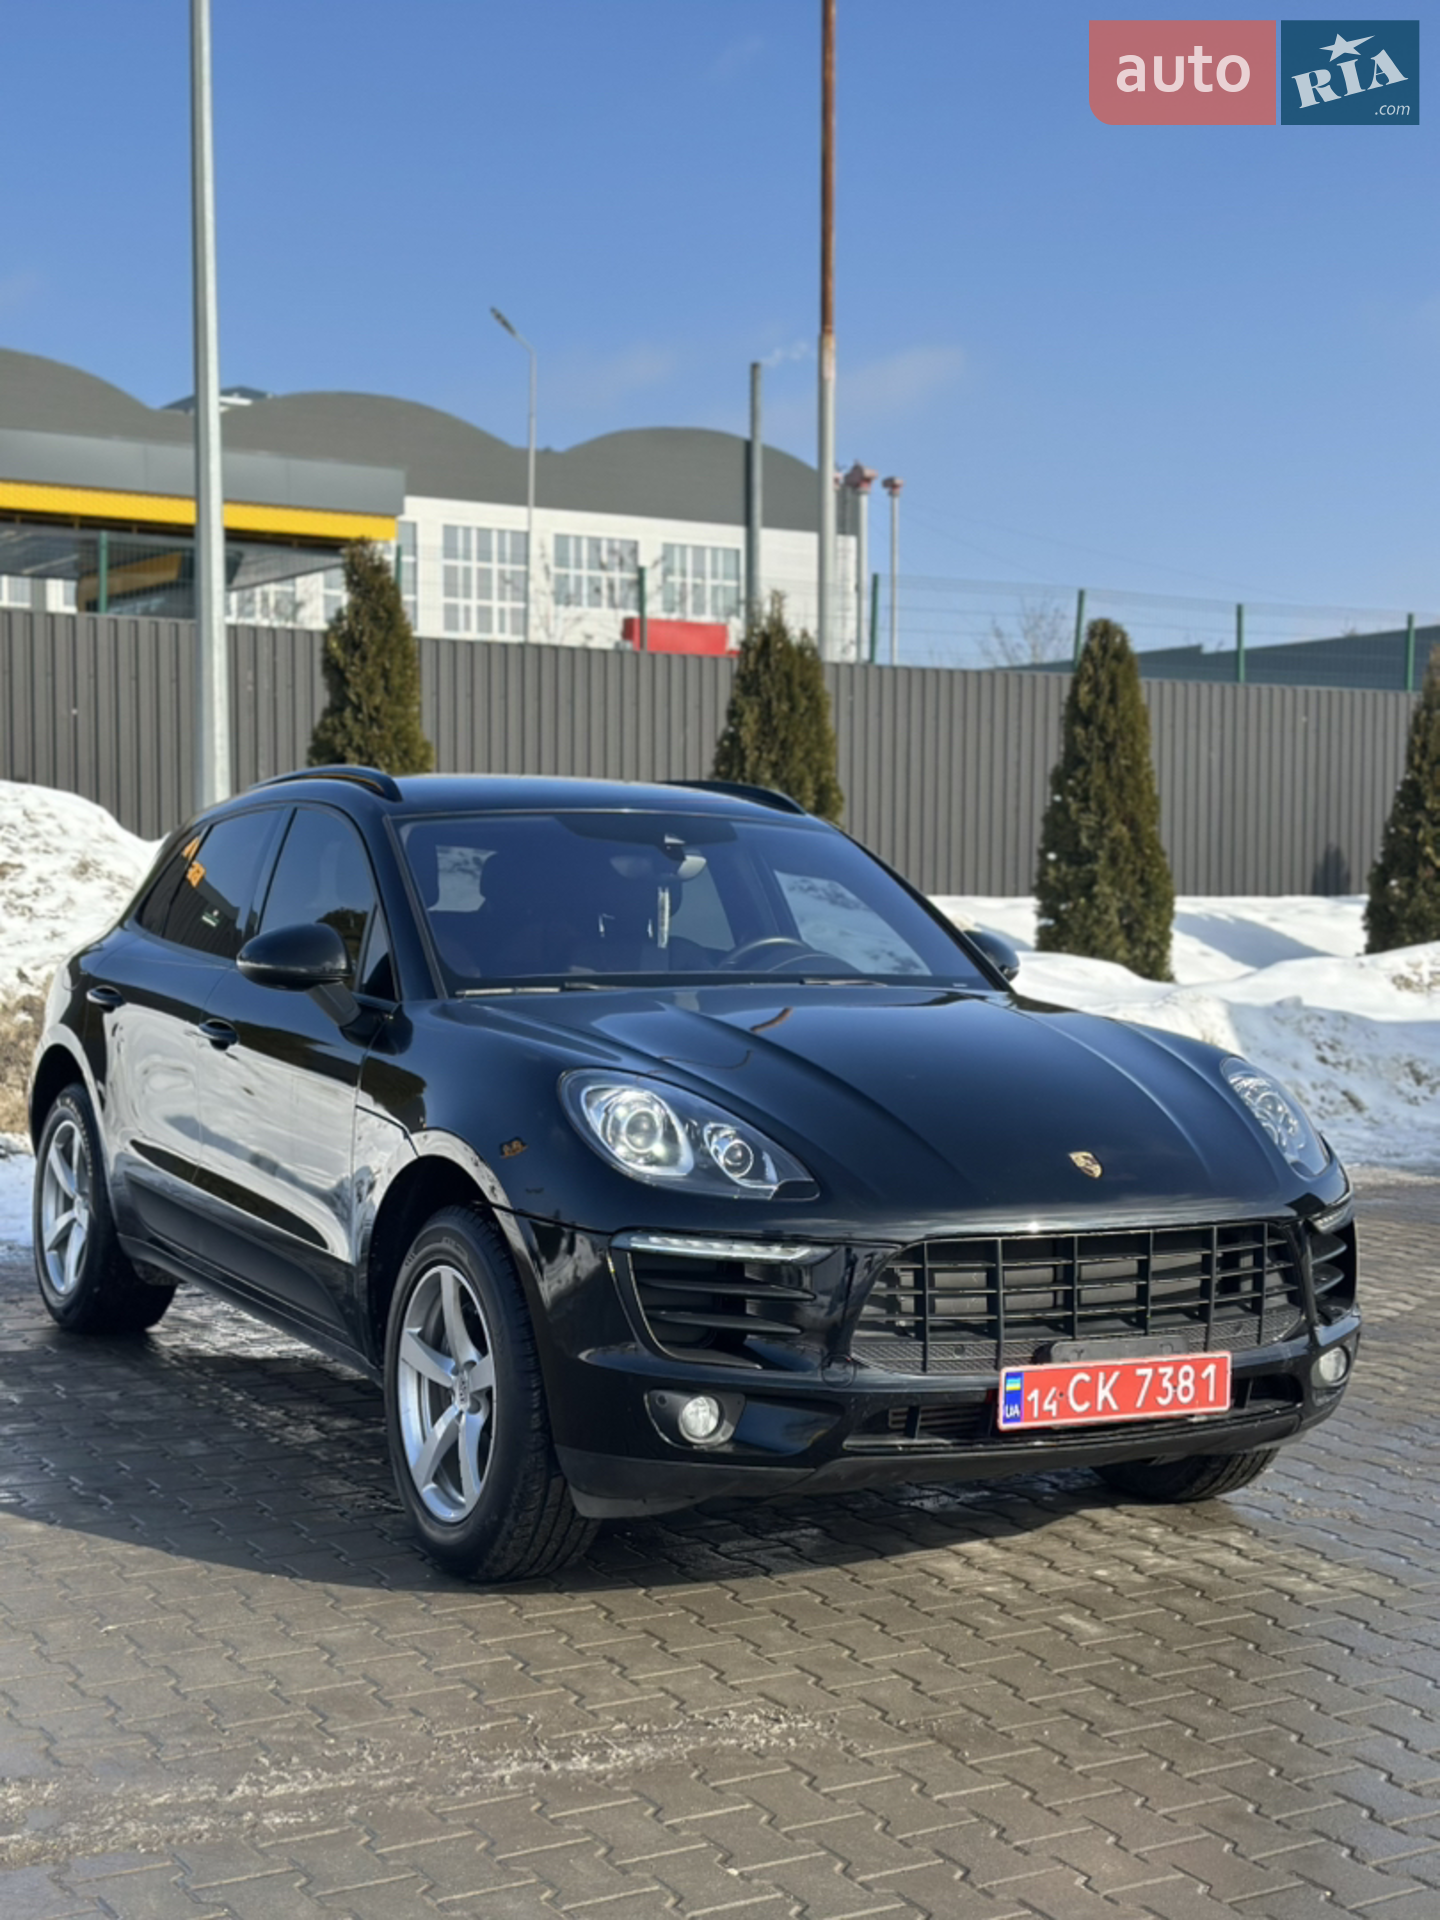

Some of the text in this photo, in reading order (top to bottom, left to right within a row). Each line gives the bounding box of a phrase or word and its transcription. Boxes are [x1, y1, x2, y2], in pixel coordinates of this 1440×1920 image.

[1026, 1363, 1217, 1418] 14 CK 7381
[1005, 1405, 1020, 1418] UA
